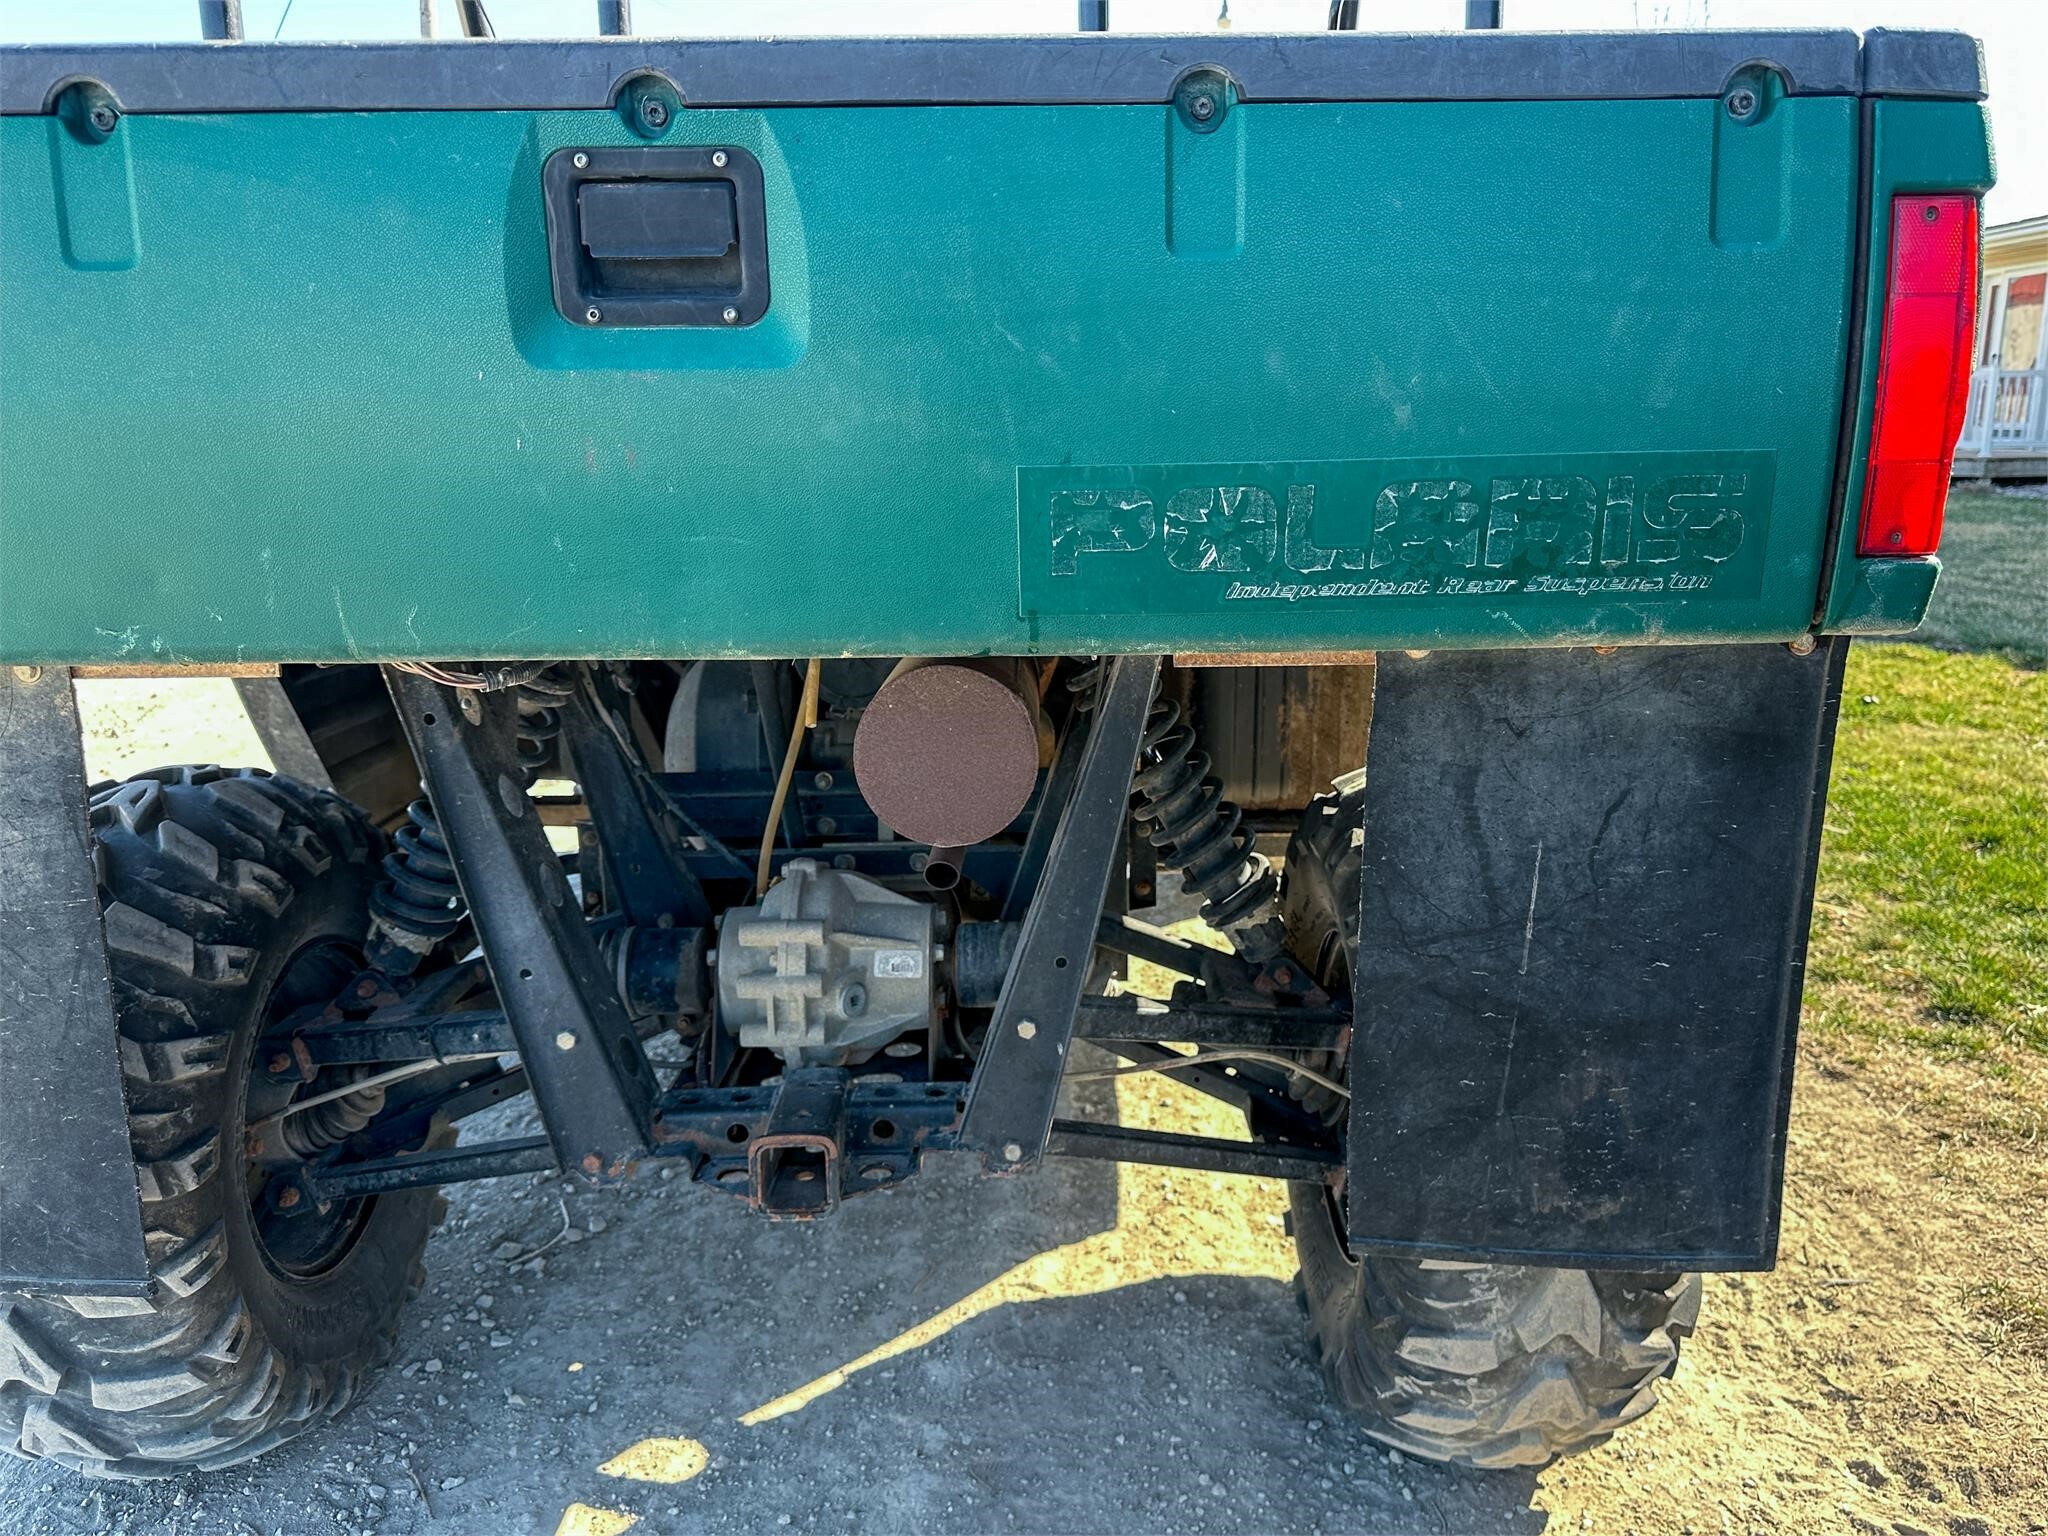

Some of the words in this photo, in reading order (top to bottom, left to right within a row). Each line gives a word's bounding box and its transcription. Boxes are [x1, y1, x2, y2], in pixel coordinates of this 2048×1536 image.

[1050, 474, 1747, 575] POLARIS
[1226, 578, 1431, 602] Independent
[1437, 575, 1518, 595] Rear
